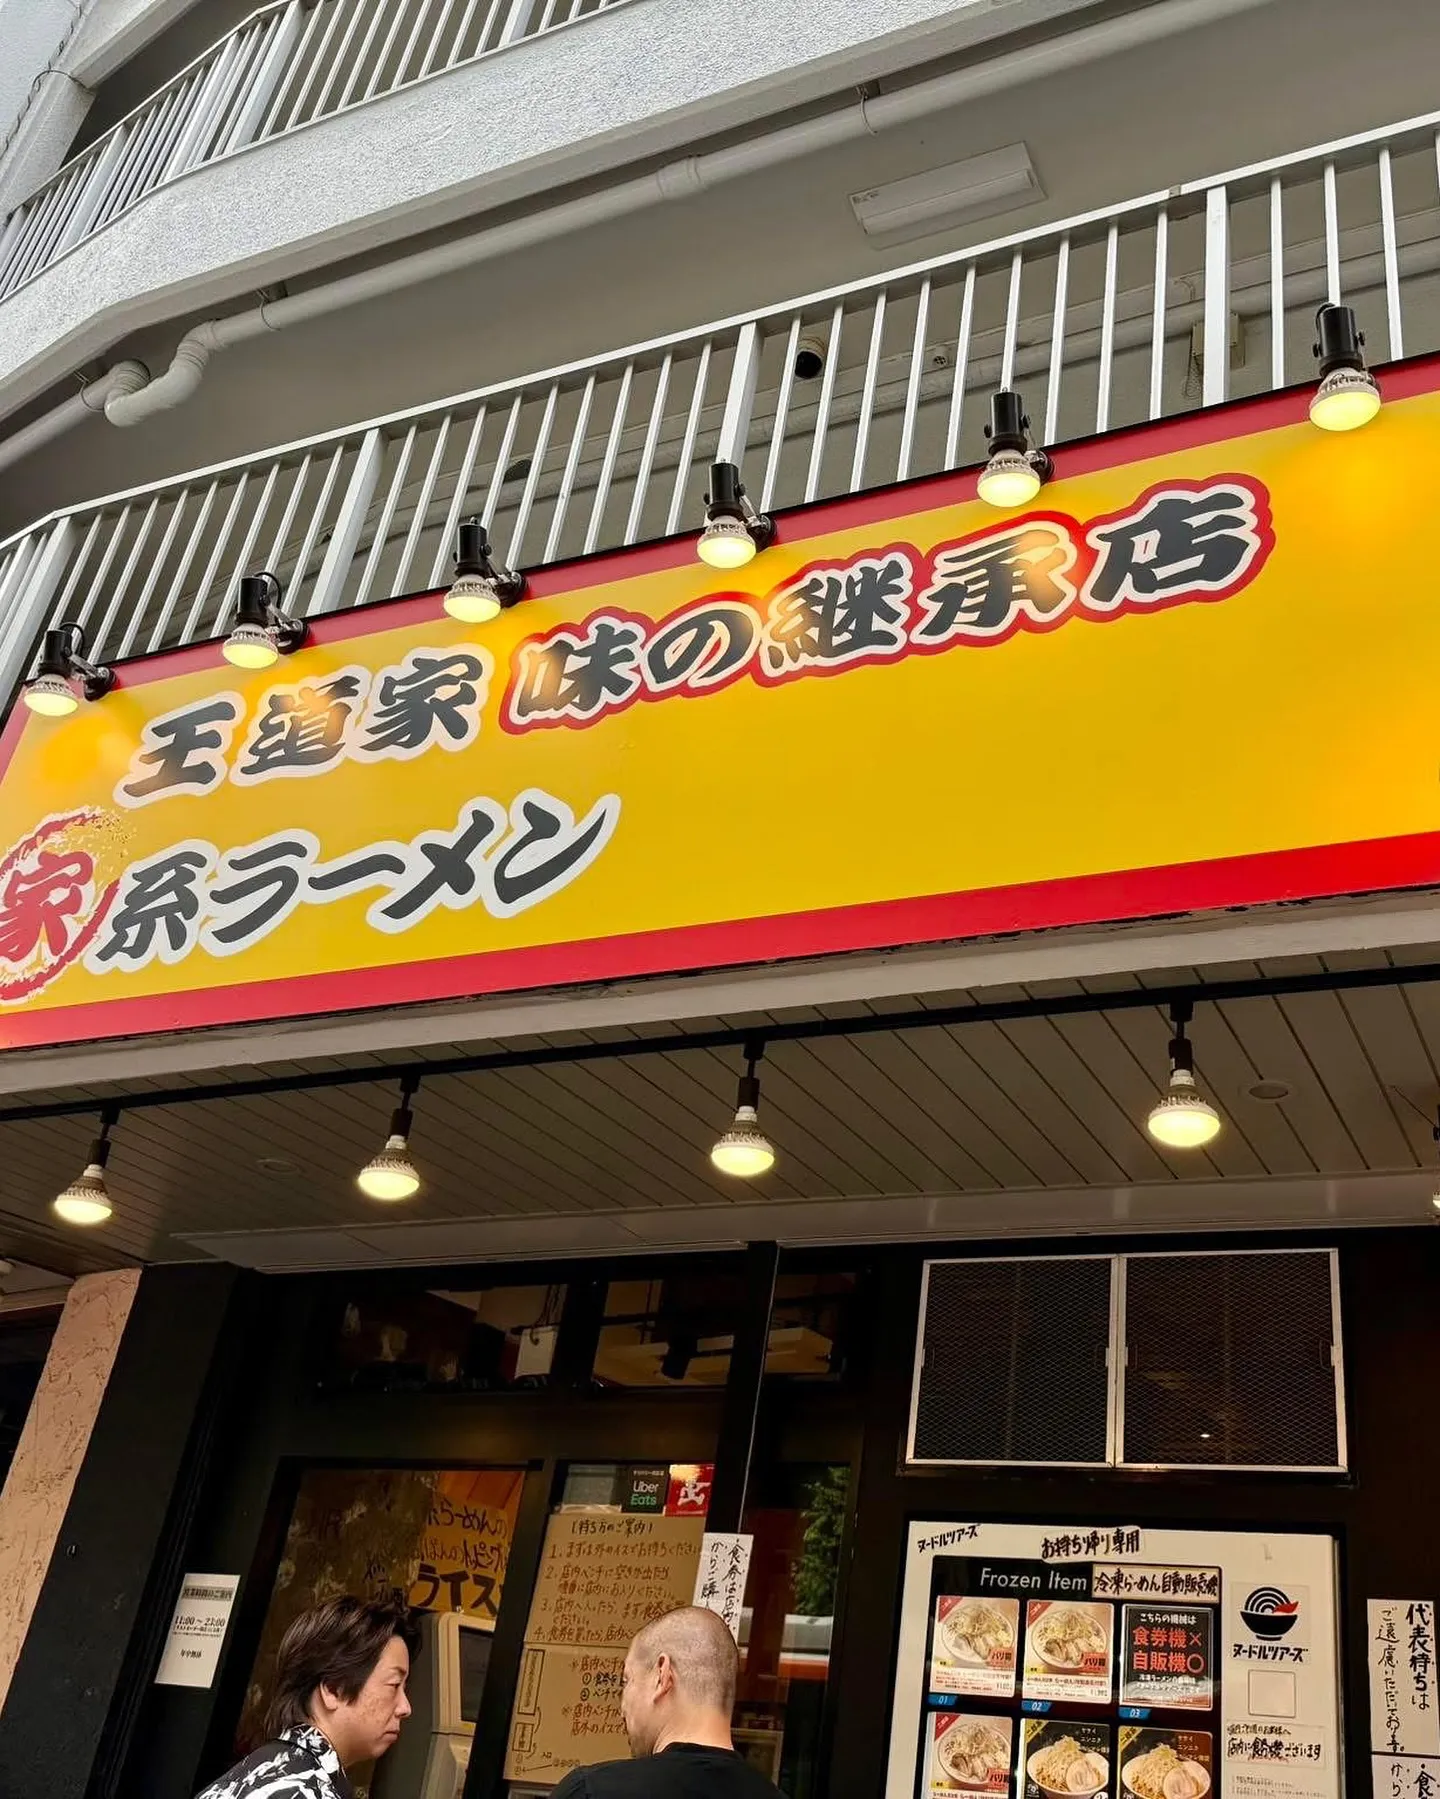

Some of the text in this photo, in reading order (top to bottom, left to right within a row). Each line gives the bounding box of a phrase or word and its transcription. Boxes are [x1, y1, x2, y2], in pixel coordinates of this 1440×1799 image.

[118, 485, 1262, 802] 王道家 味の継承店
[633, 1480, 659, 1493] Uber
[631, 1494, 657, 1506] Eats
[917, 1523, 981, 1552] ヌードルツアーズ
[1041, 1528, 1140, 1559] お持ち帰り専用
[409, 1562, 498, 1617] ライス
[980, 1567, 1088, 1591] Frozen Item
[1233, 1644, 1309, 1662] ヌードルツアーズ
[1405, 1604, 1432, 1710] 代表待ちは
[1031, 1702, 1042, 1712] 02
[1129, 1709, 1140, 1718] 03
